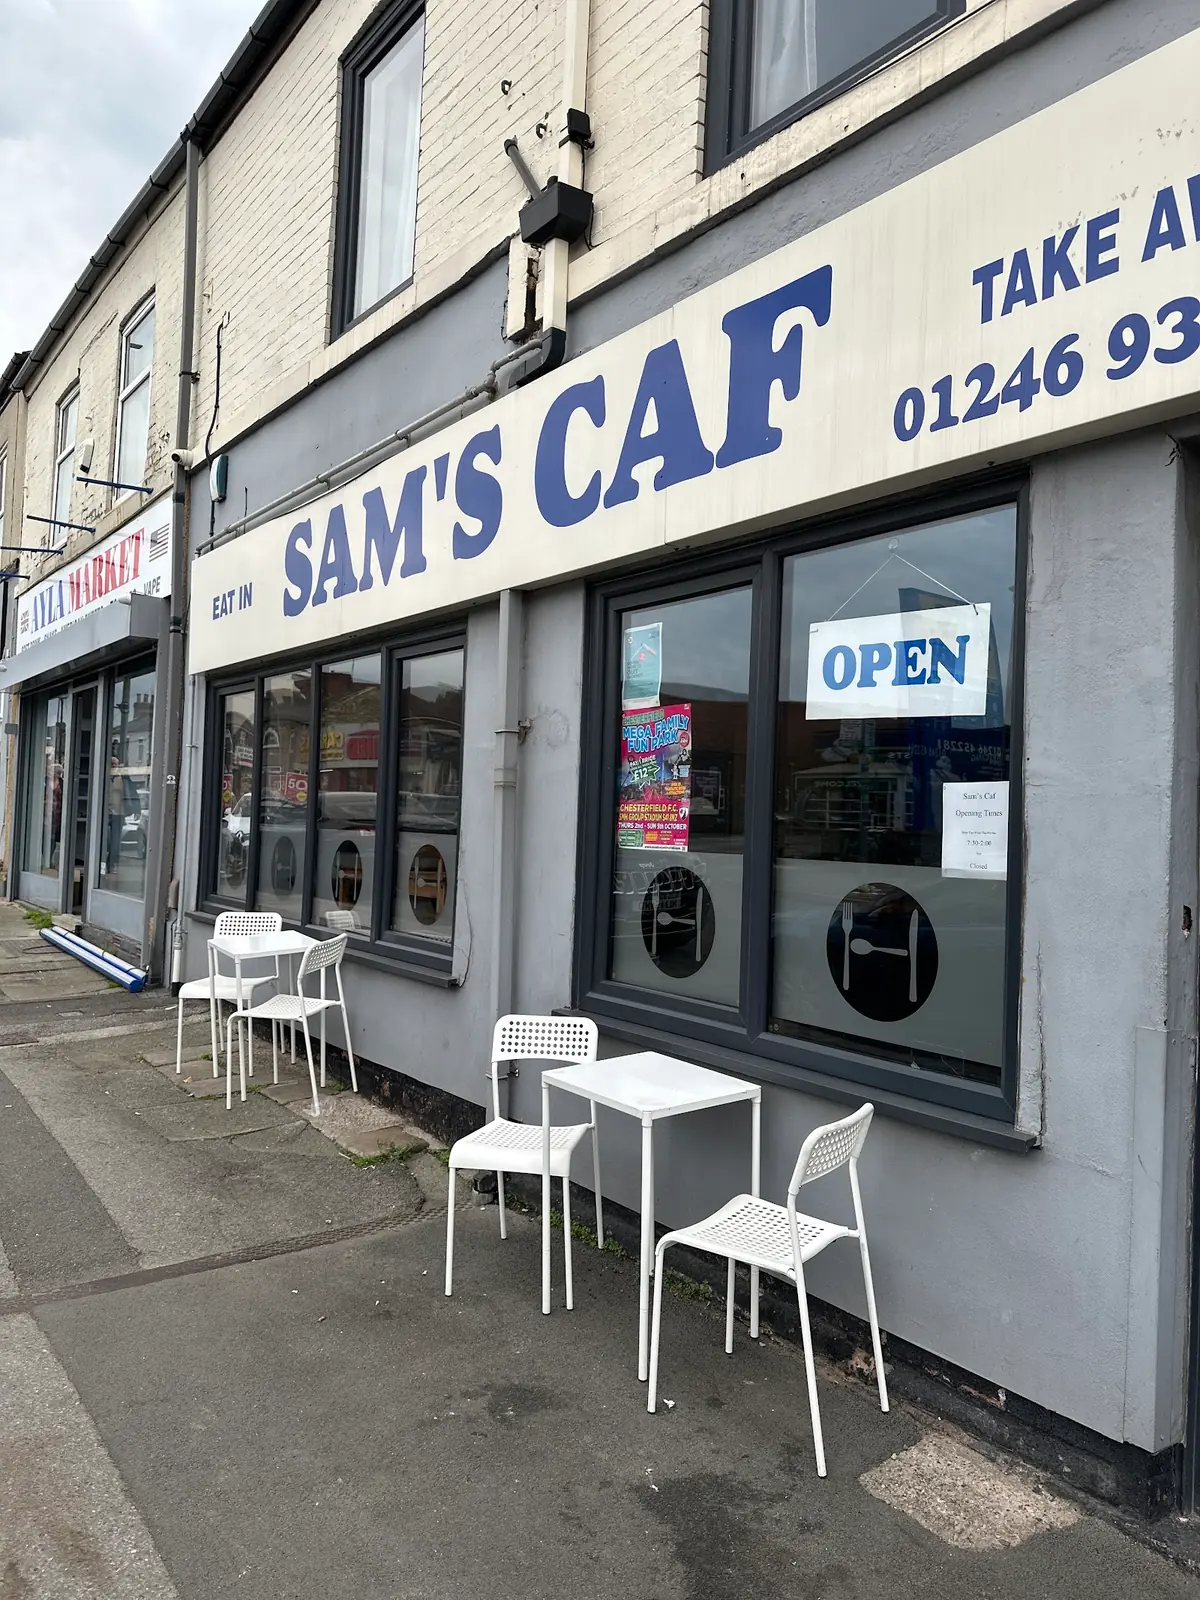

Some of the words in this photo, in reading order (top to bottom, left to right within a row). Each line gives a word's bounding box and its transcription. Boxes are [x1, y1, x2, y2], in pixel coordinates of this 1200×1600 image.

[972, 208, 1120, 325] TAKE
[893, 333, 1084, 442] 01246
[283, 423, 503, 618] SAM'S
[534, 264, 833, 528] CAF
[31, 579, 66, 635] AYLA
[68, 527, 146, 615] MARKET
[212, 595, 235, 621] EAT
[238, 582, 253, 612] IN
[822, 634, 971, 691] OPEN
[622, 725, 652, 740] MEGA
[654, 714, 690, 736] FAMILY
[627, 738, 649, 753] FUN
[651, 729, 679, 752] PARK
[620, 804, 667, 812] CHESTERFIELD
[667, 804, 679, 812] F.C.
[984, 792, 997, 800] Caf
[618, 822, 634, 830] THURS
[629, 813, 643, 821] GROUP
[955, 809, 982, 818] Opening
[984, 809, 1003, 817] Times
